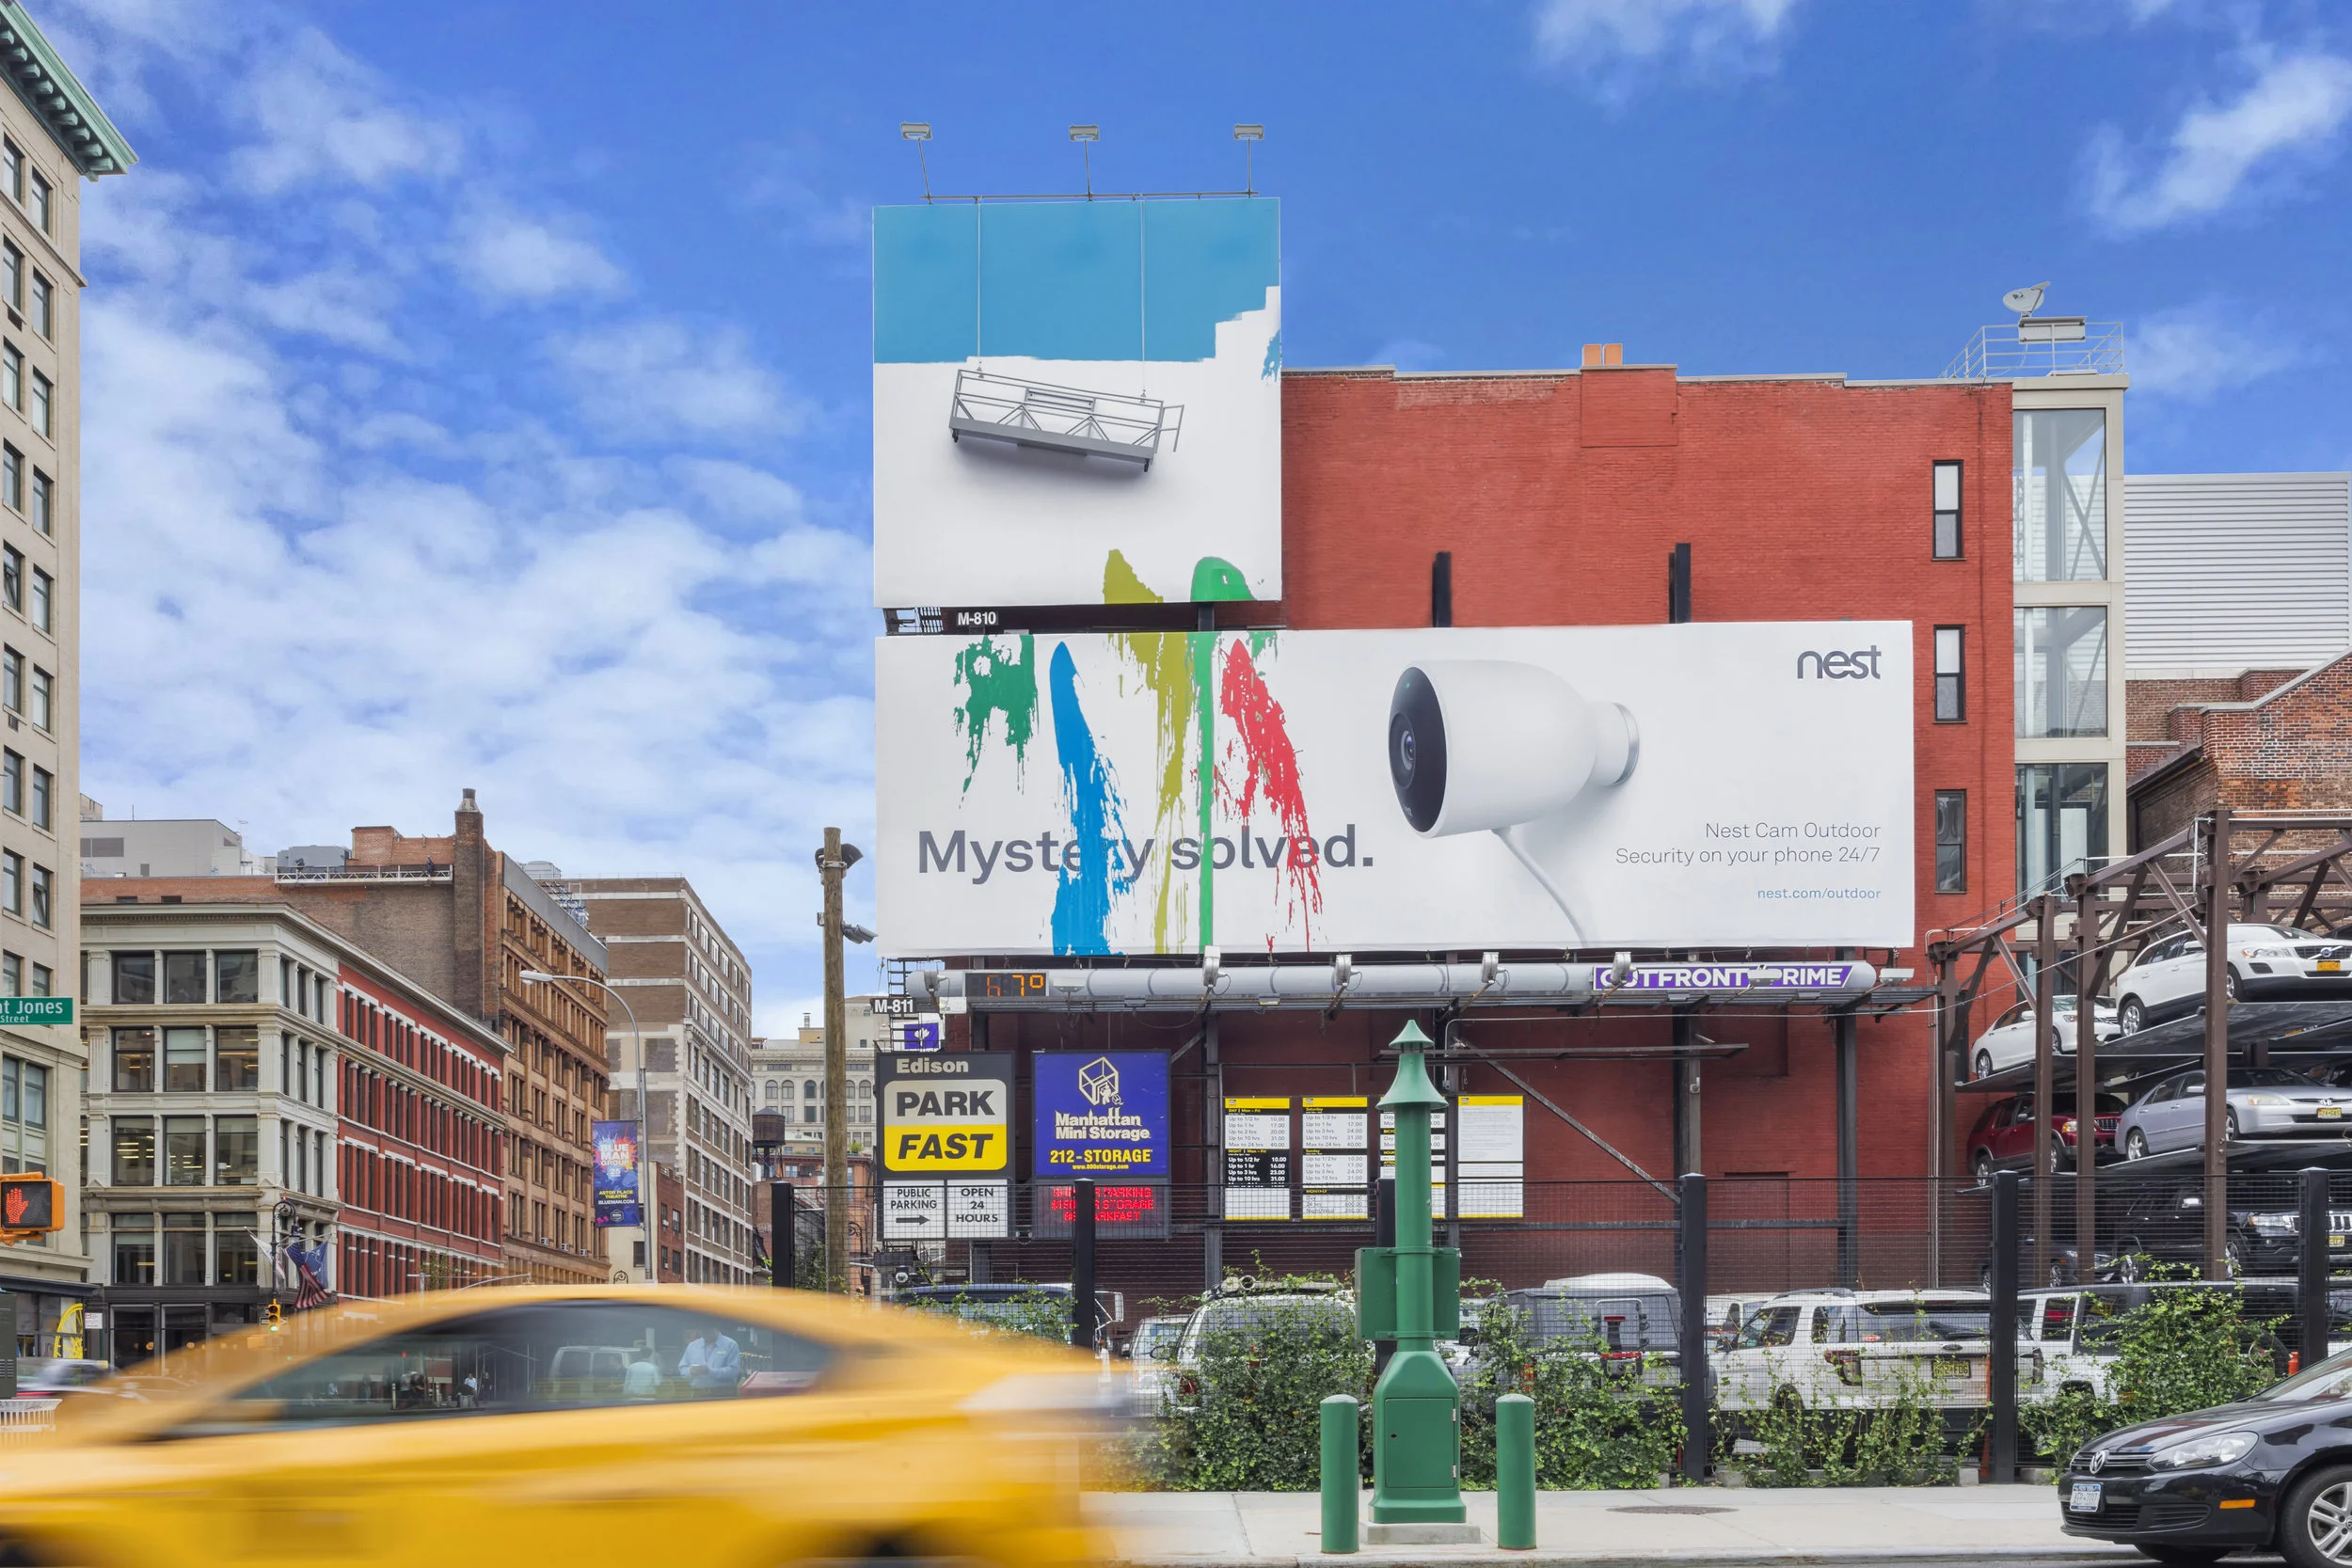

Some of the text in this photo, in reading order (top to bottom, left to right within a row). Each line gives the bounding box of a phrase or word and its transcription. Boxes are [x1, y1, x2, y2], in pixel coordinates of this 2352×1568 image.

[956, 611, 997, 626] M-810
[1797, 645, 1881, 680] nest
[1706, 822, 1881, 839] Nest Cam Outdoor
[1616, 847, 1880, 866] Security on your phone 24/7
[1757, 887, 1881, 900] nest.com/outdoor
[16, 1000, 63, 1014] Jones
[874, 999, 913, 1013] M-811
[897, 1058, 969, 1074] Edison
[896, 1091, 995, 1117] PARK
[1055, 1107, 1142, 1126] Manhattan
[1056, 1126, 1150, 1141] Mini Storage
[601, 1143, 629, 1151] BLUE
[898, 1133, 993, 1159] FAST
[601, 1151, 629, 1160] MAN
[897, 1188, 931, 1198] PUBLIC
[961, 1188, 994, 1197] OPEN
[1104, 1187, 1152, 1198] PARKING
[890, 1199, 938, 1210] PARKING
[970, 1201, 985, 1210] 24
[1103, 1199, 1154, 1210] STORAGE
[955, 1213, 999, 1223] HOURS
